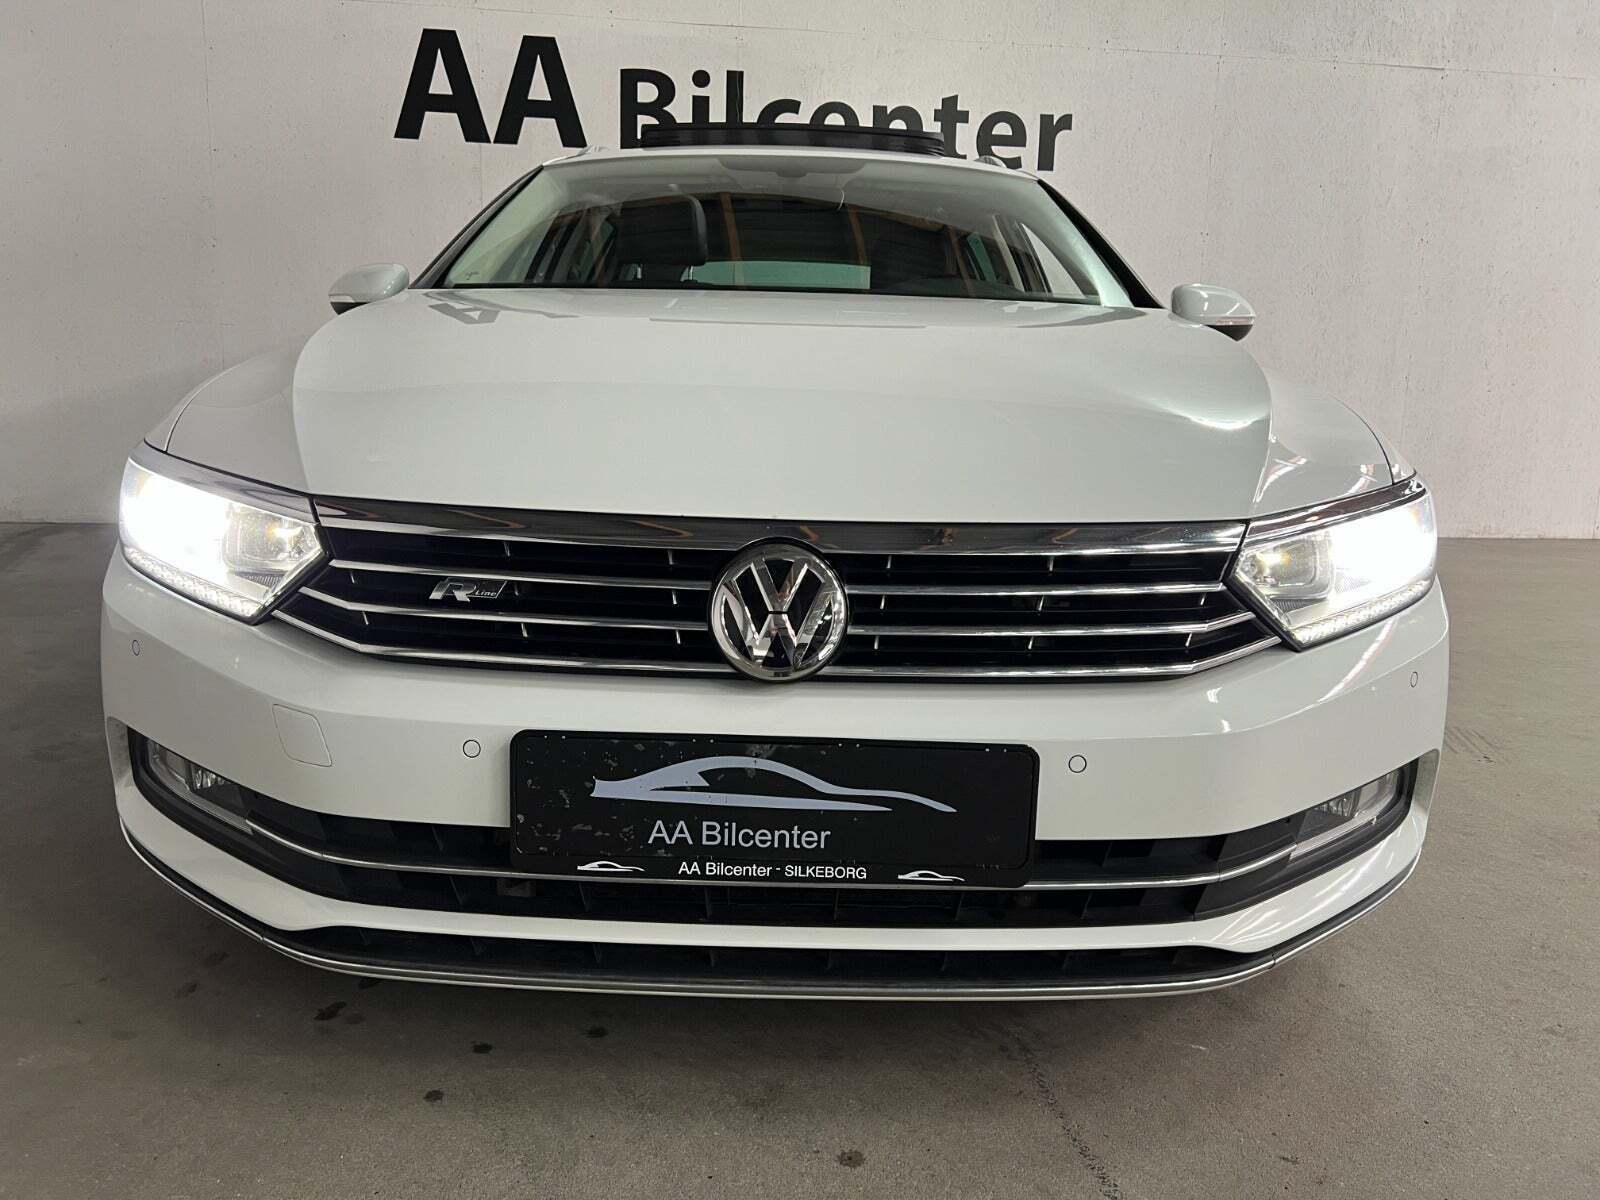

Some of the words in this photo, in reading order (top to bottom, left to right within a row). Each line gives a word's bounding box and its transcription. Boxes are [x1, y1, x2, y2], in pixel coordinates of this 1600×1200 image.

[394, 28, 588, 149] AA
[429, 577, 477, 603] R
[647, 819, 694, 846] AA
[701, 820, 832, 849] Bilcenter
[678, 861, 701, 876] AA
[705, 861, 773, 878] Bilcenter
[784, 864, 868, 880] SILKEBORG
